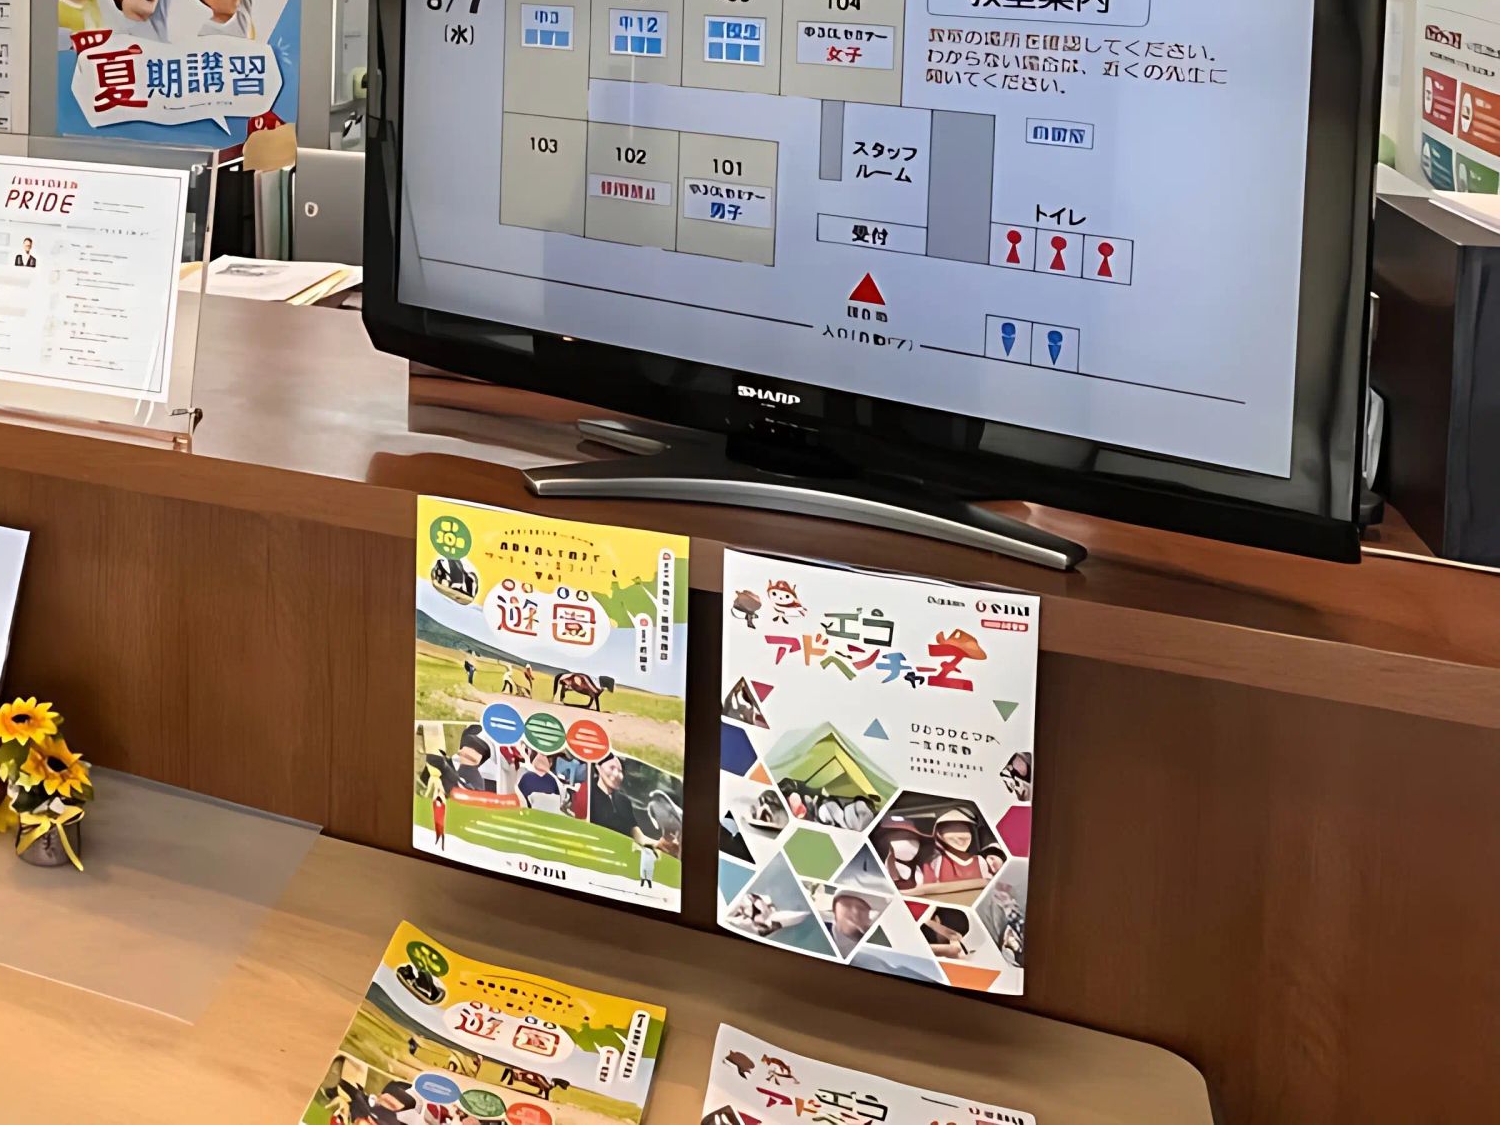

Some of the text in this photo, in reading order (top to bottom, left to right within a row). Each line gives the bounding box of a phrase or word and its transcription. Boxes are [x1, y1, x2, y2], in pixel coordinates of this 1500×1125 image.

[825, 45, 863, 63] 女子
[86, 43, 267, 113] 夏期講習
[529, 136, 559, 153] 103
[852, 140, 918, 162] スタッフ
[615, 146, 647, 165] 102
[711, 158, 743, 176] 101
[855, 164, 912, 183] ルーム
[4, 188, 76, 214] PRIDE
[1035, 203, 1087, 226] トイレ
[851, 225, 889, 246] 受付
